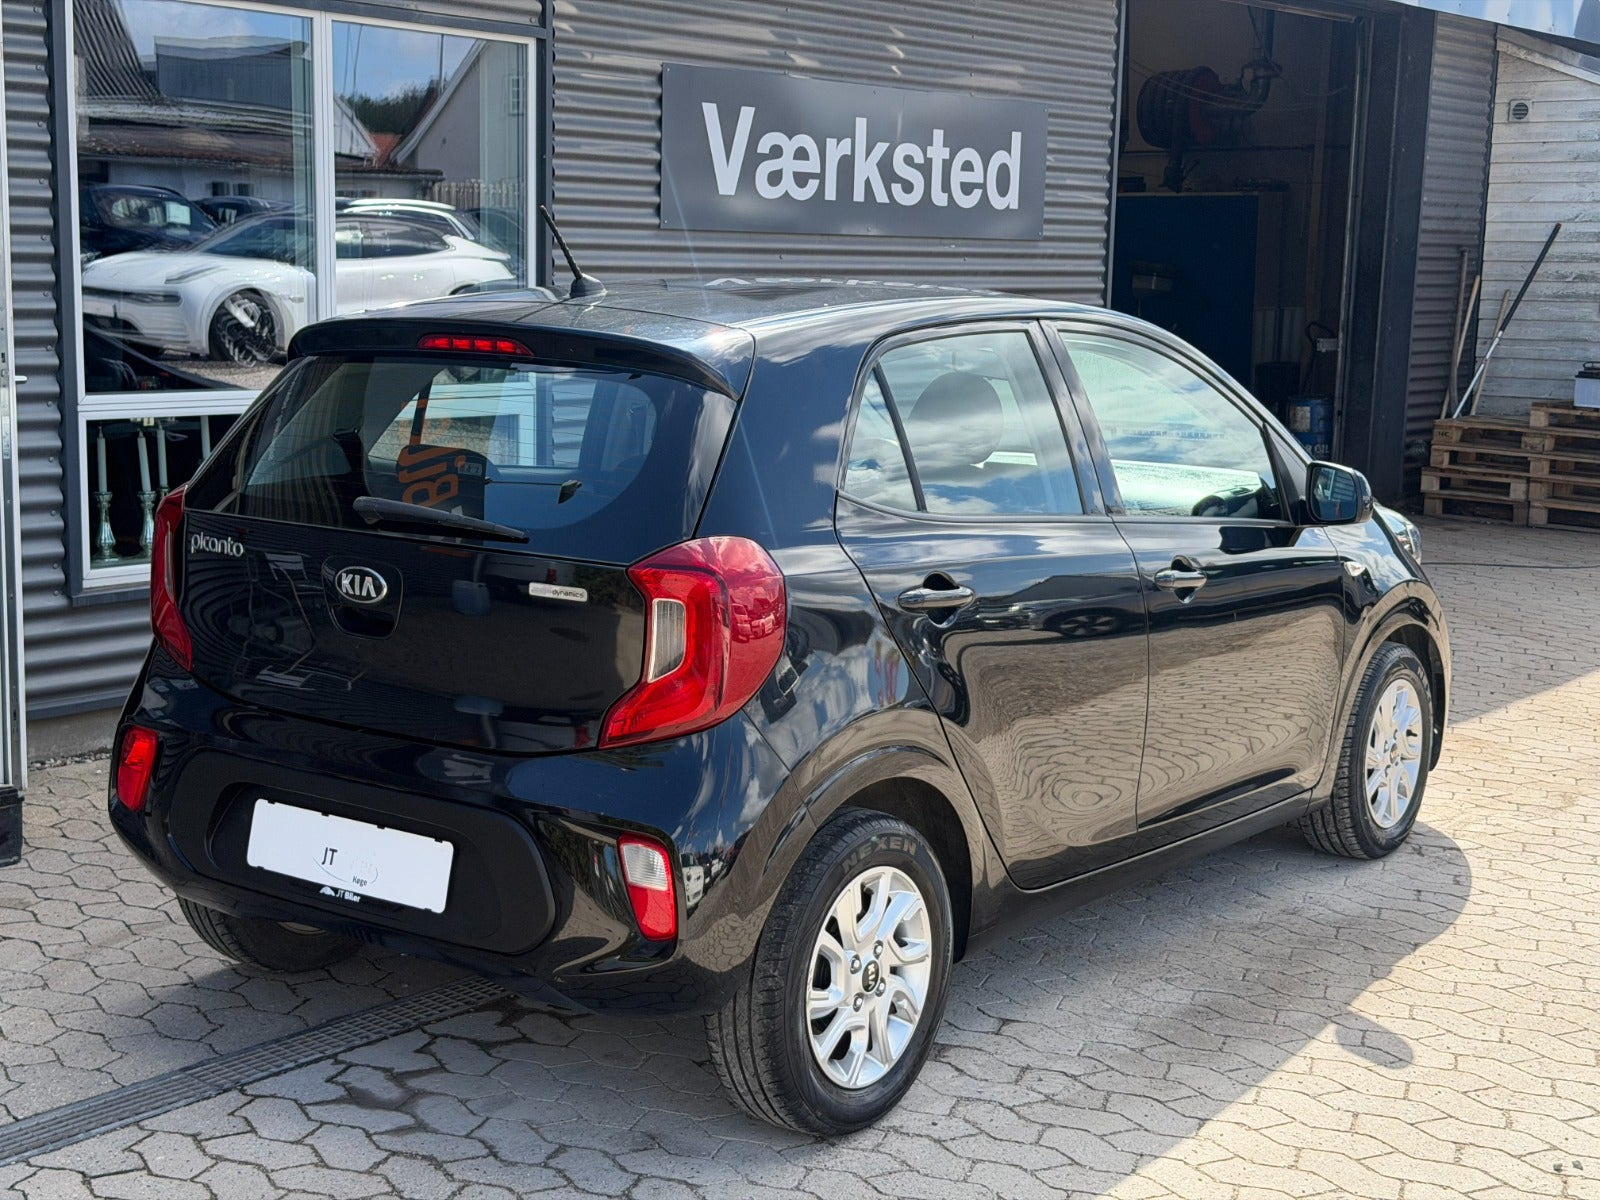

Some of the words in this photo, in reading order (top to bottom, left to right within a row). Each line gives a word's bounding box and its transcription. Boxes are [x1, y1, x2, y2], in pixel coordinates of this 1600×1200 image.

[701, 102, 1022, 209] Værksted
[191, 531, 244, 557] picanto
[341, 572, 377, 598] KIA
[321, 847, 338, 866] JT
[842, 835, 918, 873] NEXEN
[336, 889, 345, 899] JT
